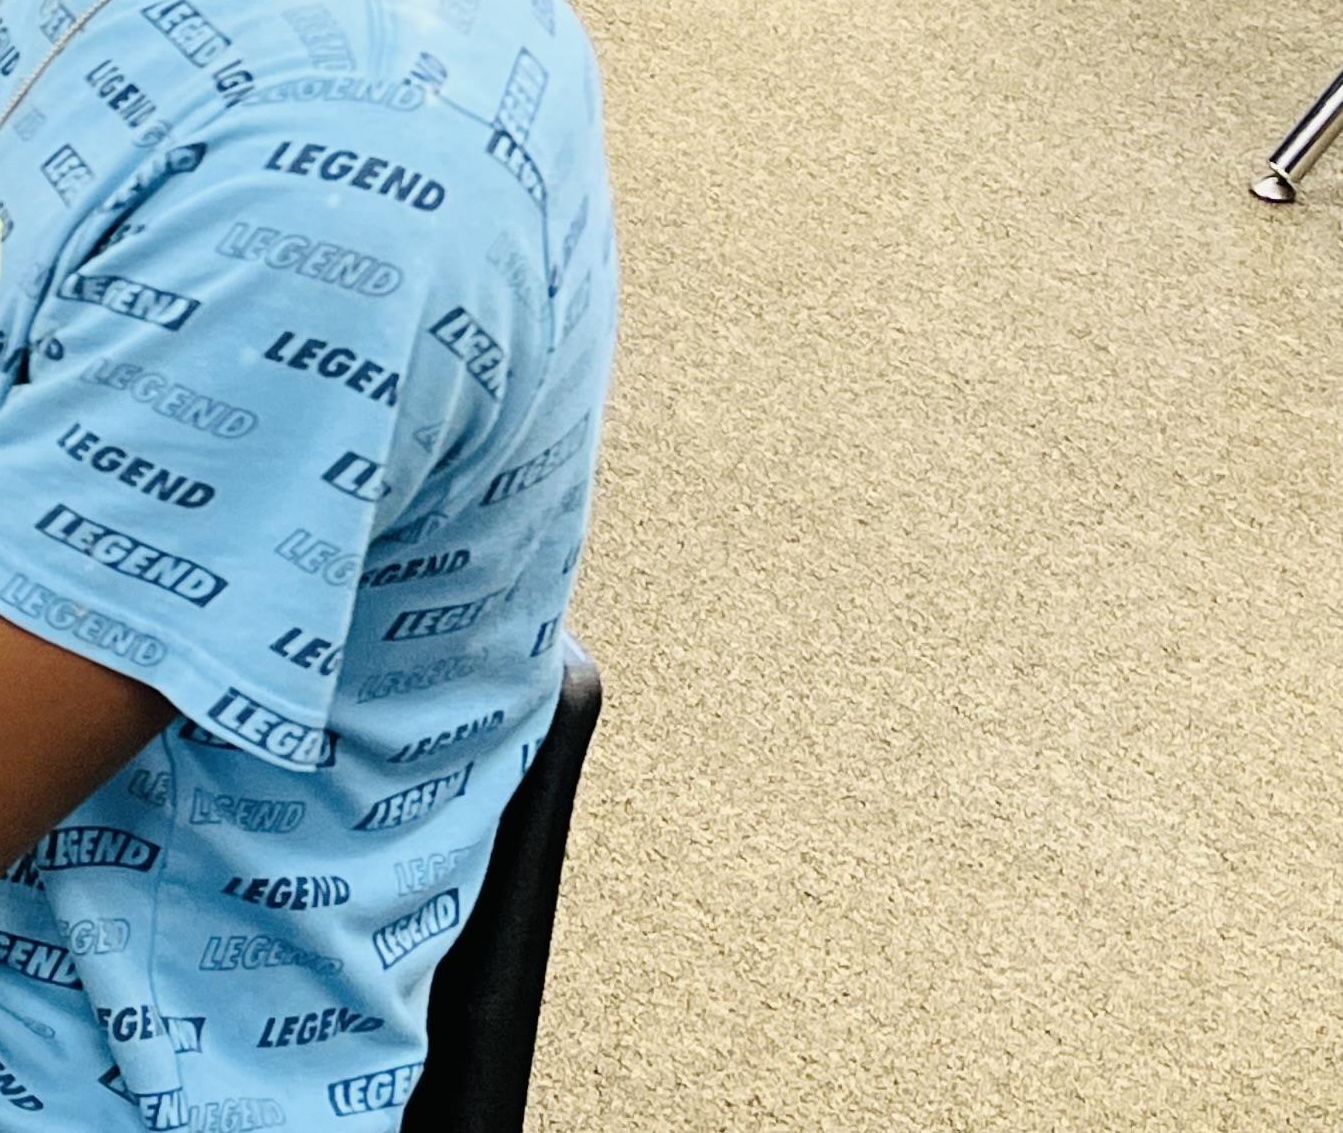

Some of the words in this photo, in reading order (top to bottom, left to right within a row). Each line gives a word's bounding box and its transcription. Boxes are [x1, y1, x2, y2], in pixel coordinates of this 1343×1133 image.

[263, 141, 446, 212] LEGEND
[216, 221, 404, 298] LEGEND
[80, 358, 260, 439] LEGEND
[56, 422, 216, 509] LEGEND
[35, 504, 228, 608] LEGEND
[220, 875, 351, 911] LEGEND
[372, 887, 461, 970] LEGEND
[257, 1007, 385, 1049] LEGEND
